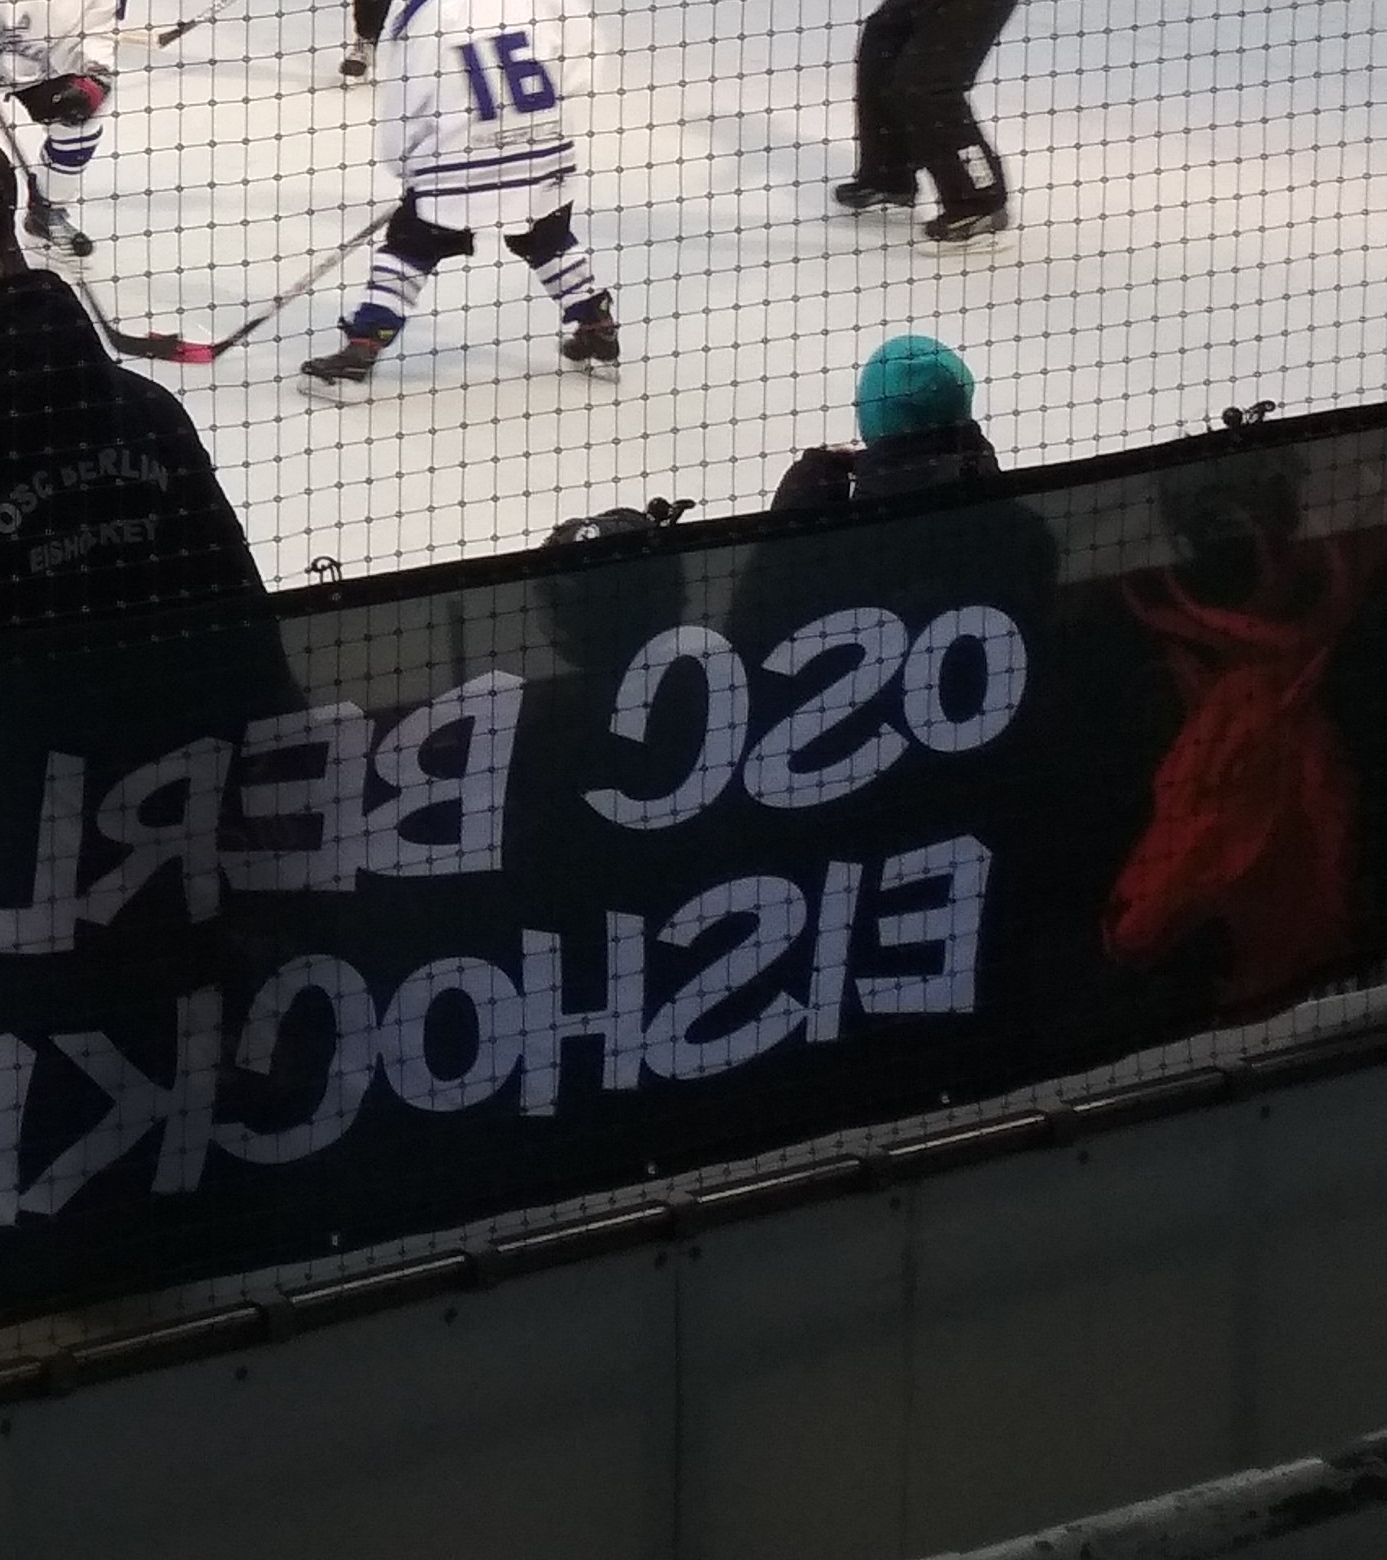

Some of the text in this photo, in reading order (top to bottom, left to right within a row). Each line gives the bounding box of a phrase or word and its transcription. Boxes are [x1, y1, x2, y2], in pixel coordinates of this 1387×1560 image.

[456, 30, 555, 121] 16
[61, 447, 169, 494] BERLIN
[30, 518, 161, 573] EISHOKEY
